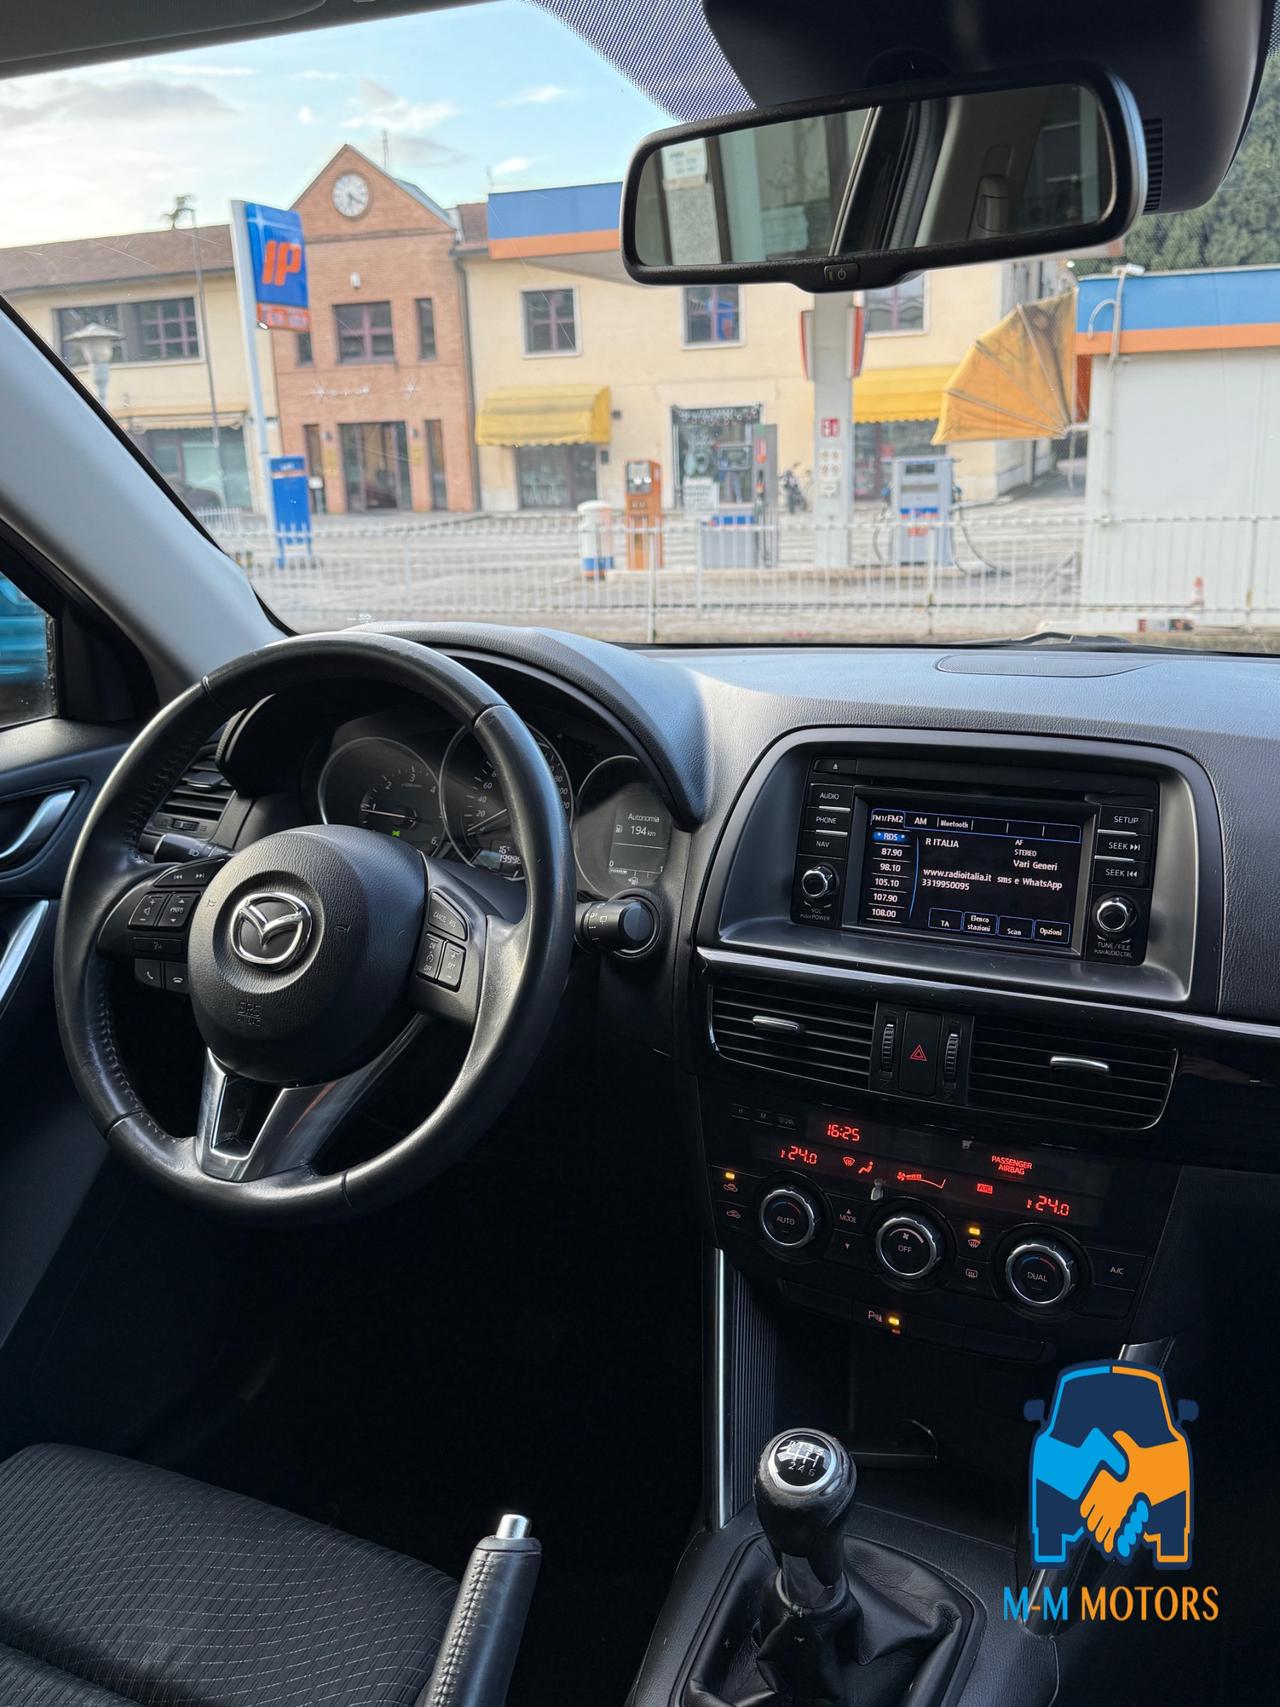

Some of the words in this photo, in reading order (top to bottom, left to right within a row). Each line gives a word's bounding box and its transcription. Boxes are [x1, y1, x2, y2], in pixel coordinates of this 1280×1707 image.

[262, 240, 300, 286] IP
[819, 792, 840, 801] AUDIO
[628, 813, 660, 823] Autonomia
[815, 816, 837, 825] PHONE
[872, 814, 904, 824] FM1/FM2
[914, 817, 928, 826] AM
[1113, 815, 1139, 824] SETUP
[940, 819, 969, 829] Bluetooth
[630, 825, 647, 836] 194
[883, 832, 899, 841] RDS
[816, 840, 830, 848] NAV
[925, 837, 931, 846] R
[933, 838, 959, 848] ITALIA
[1108, 841, 1128, 850] SEEK
[881, 847, 903, 857] 87.90
[1014, 849, 1038, 858] STEREO
[880, 862, 901, 872] 98.10
[1013, 859, 1030, 869] Vari
[1033, 861, 1058, 871] Generi
[1105, 868, 1125, 877] SEEK
[875, 877, 900, 888] 105.10
[922, 878, 970, 891] 3319950095
[923, 868, 992, 882] www.radioitalia.it
[997, 876, 1012, 885] sms
[1014, 877, 1020, 885] e
[1022, 877, 1063, 891] WhatsApp
[873, 892, 898, 903] 107.90
[871, 907, 897, 918] 108.00
[941, 919, 950, 927] TA
[970, 914, 990, 923] Elenco
[967, 923, 991, 932] stazioni
[1007, 927, 1022, 936] Scan
[1039, 927, 1062, 937] Opzioni
[826, 1123, 860, 1142] 16:25
[787, 1145, 818, 1165] 24.0
[991, 1155, 1033, 1169] PASSENGER
[998, 1163, 1026, 1176] AIRBAG
[1035, 1194, 1070, 1217] 24.0
[776, 1215, 796, 1226] AUTO
[839, 1213, 857, 1224] MODE
[897, 1244, 912, 1253] OFF
[1110, 1266, 1125, 1275] A/C
[1027, 1271, 1048, 1283] DUAL
[788, 1461, 796, 1471] 2
